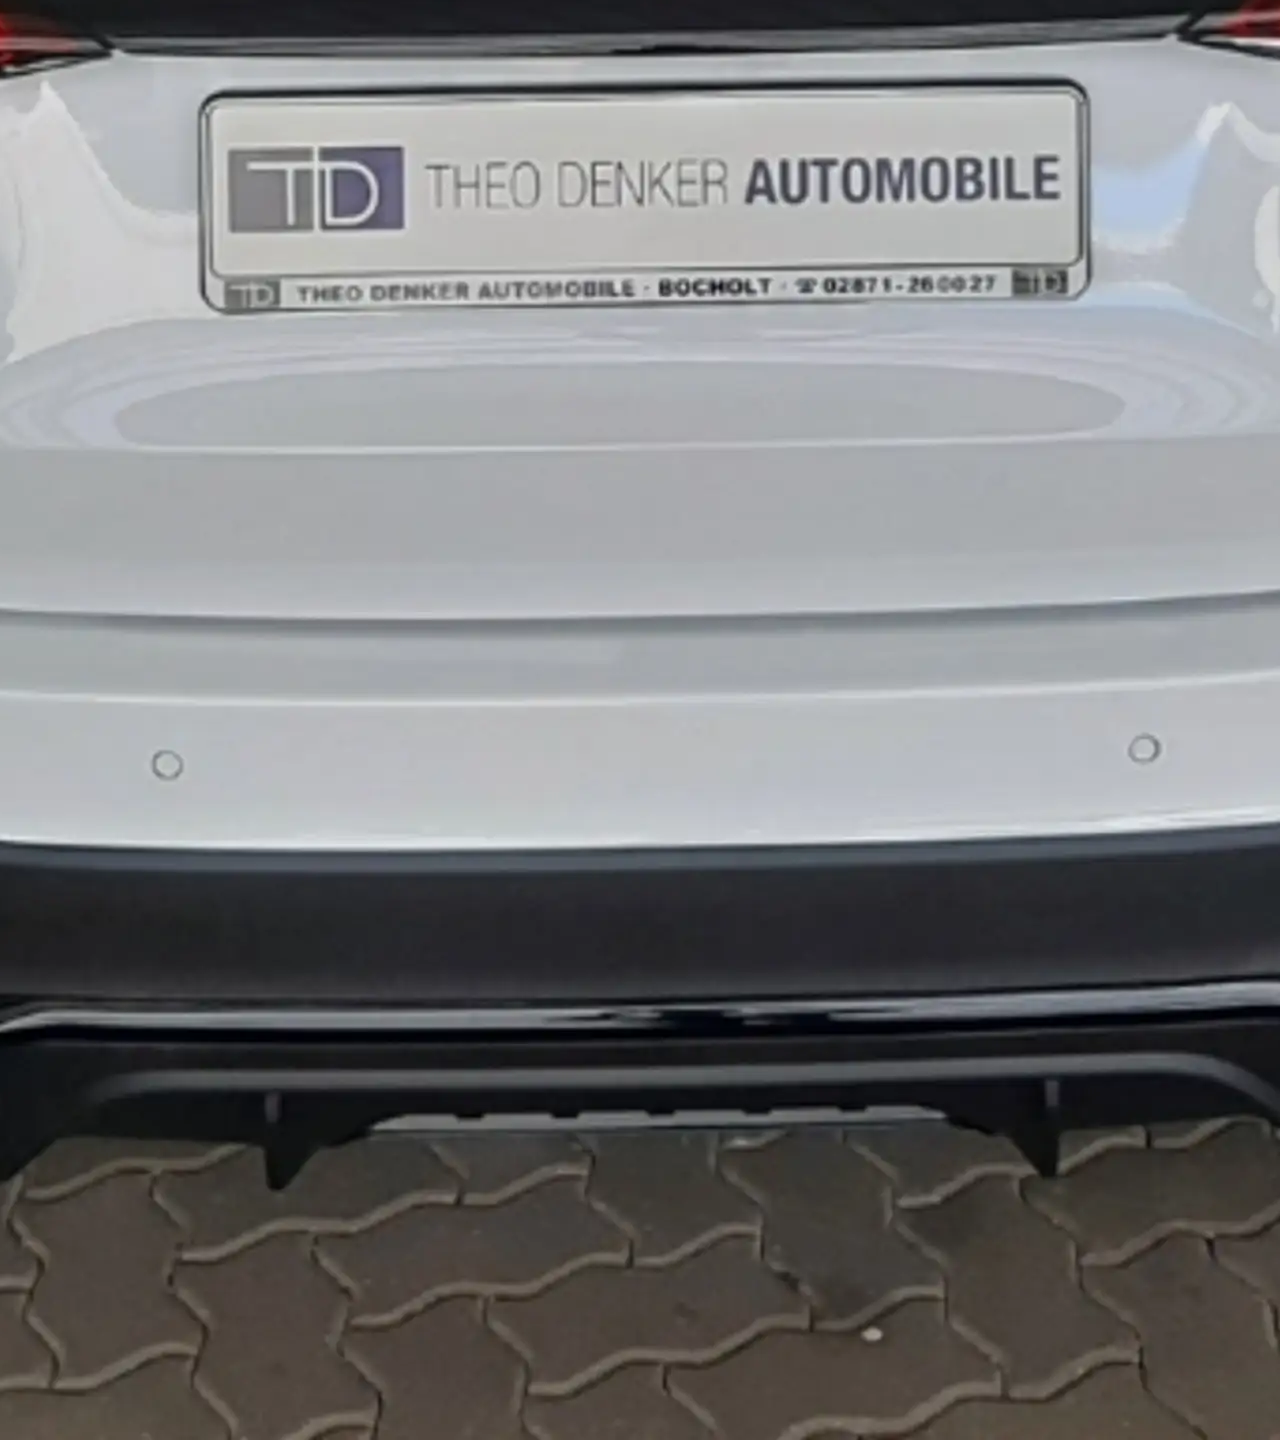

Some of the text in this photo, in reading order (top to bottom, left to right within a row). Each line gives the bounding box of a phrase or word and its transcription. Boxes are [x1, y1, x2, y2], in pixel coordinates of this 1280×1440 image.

[246, 160, 380, 227] TD
[425, 154, 1061, 210] THEO DENKER AUTOMOBILE
[296, 285, 362, 304] THEO
[369, 283, 469, 302] DENKER
[477, 280, 636, 301] AUTOMOBILE
[658, 276, 773, 297] BOCHOLT
